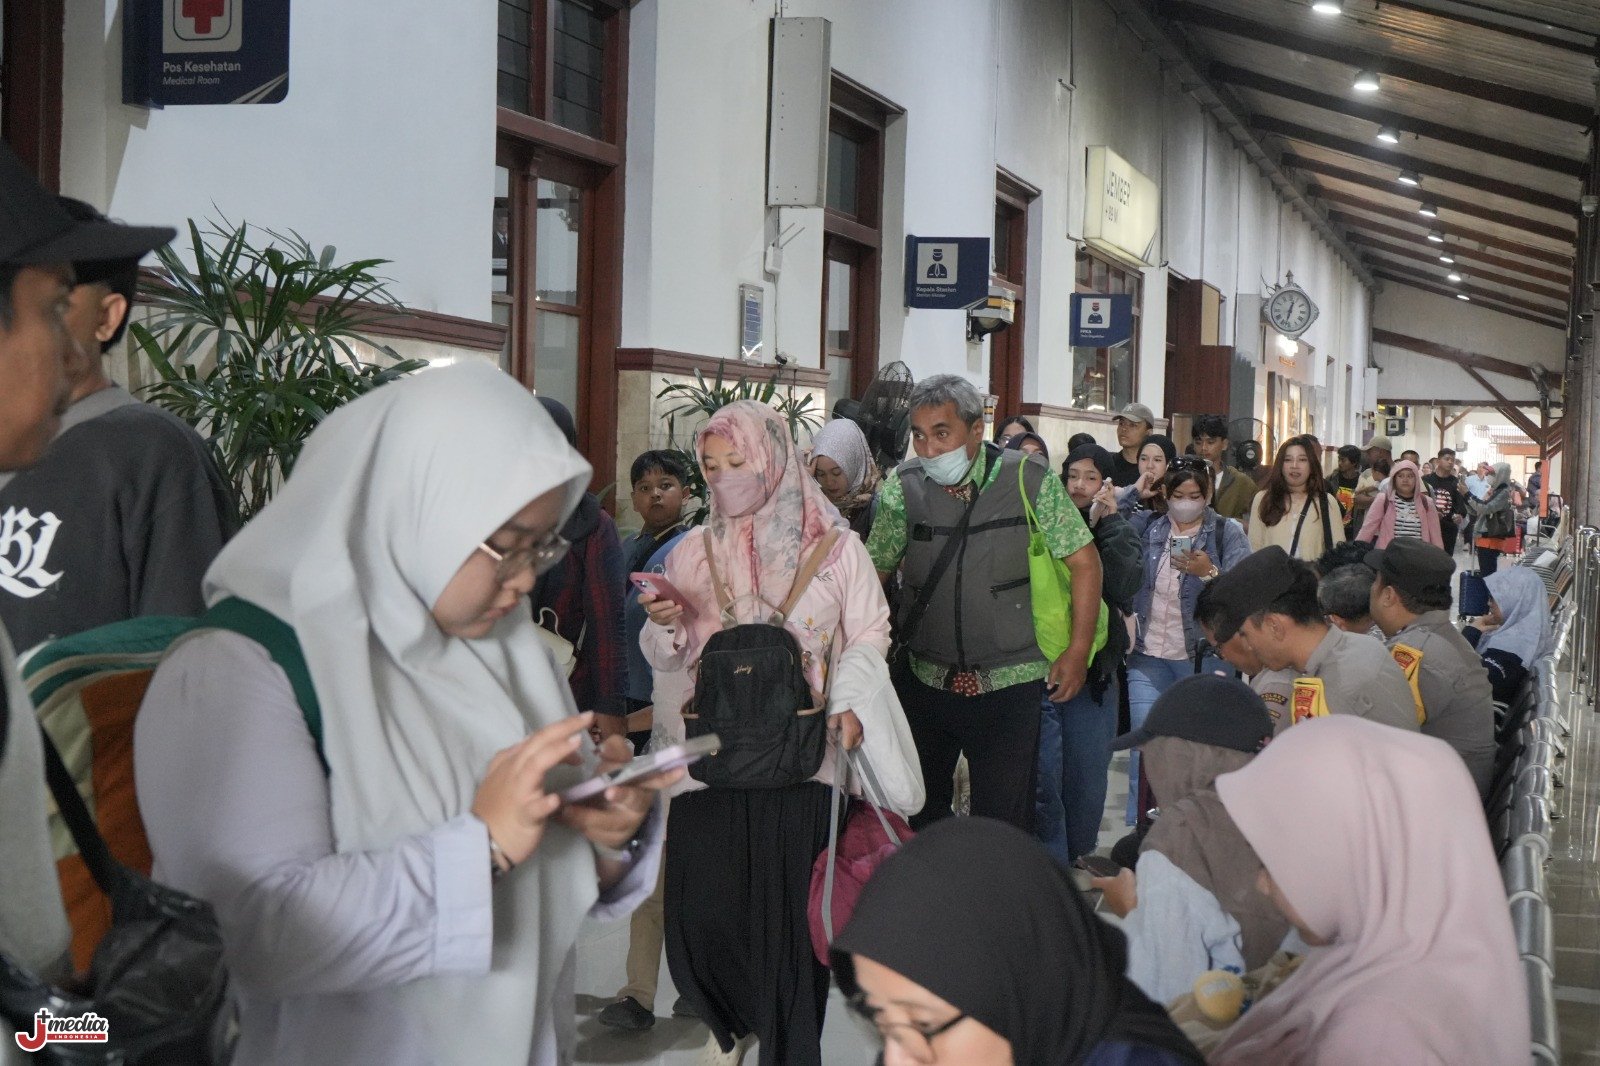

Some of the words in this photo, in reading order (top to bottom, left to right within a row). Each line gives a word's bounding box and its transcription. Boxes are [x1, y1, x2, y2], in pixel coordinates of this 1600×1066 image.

[163, 62, 182, 73] Pos
[184, 61, 242, 72] Kesehatan
[162, 76, 196, 85] Medical
[197, 75, 220, 85] Room
